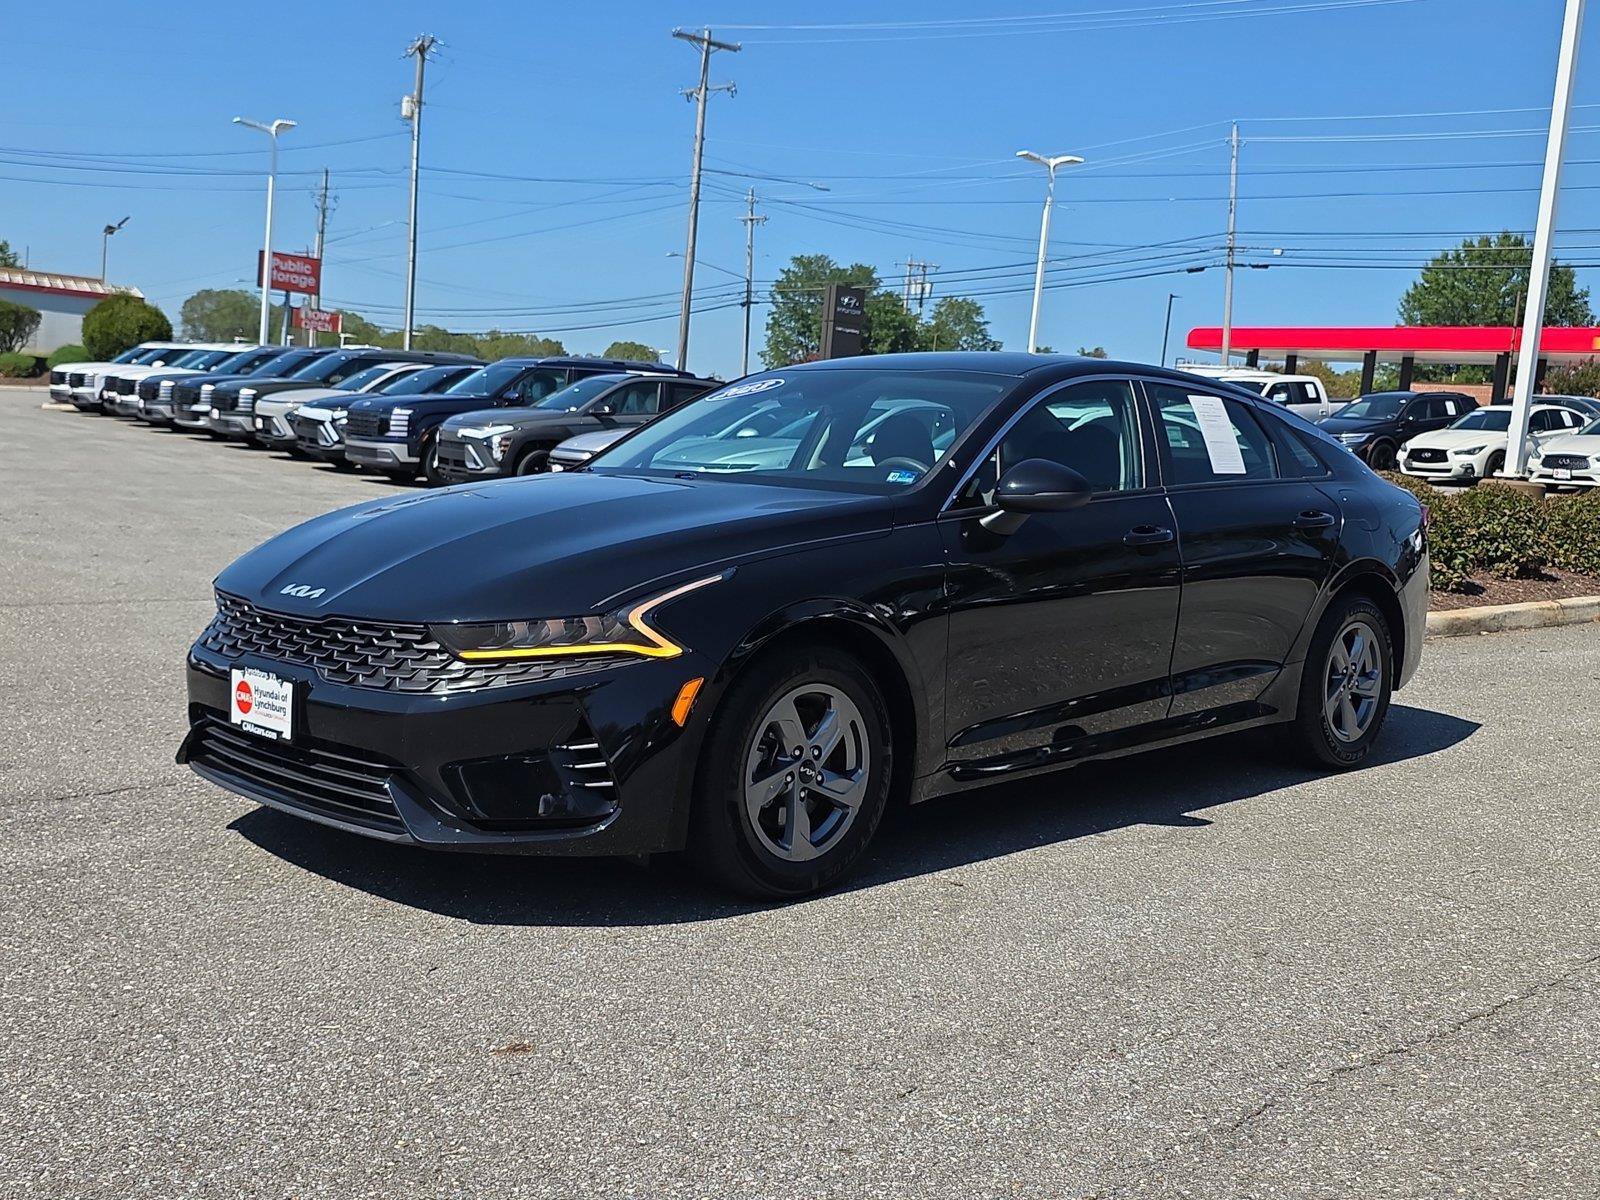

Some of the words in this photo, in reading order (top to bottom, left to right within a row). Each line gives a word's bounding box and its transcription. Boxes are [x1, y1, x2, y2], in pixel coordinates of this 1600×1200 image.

[271, 269, 316, 288] torage
[280, 583, 326, 599] KIA
[254, 685, 280, 701] Hyundai
[280, 694, 288, 703] of
[254, 698, 287, 716] Lynchburg
